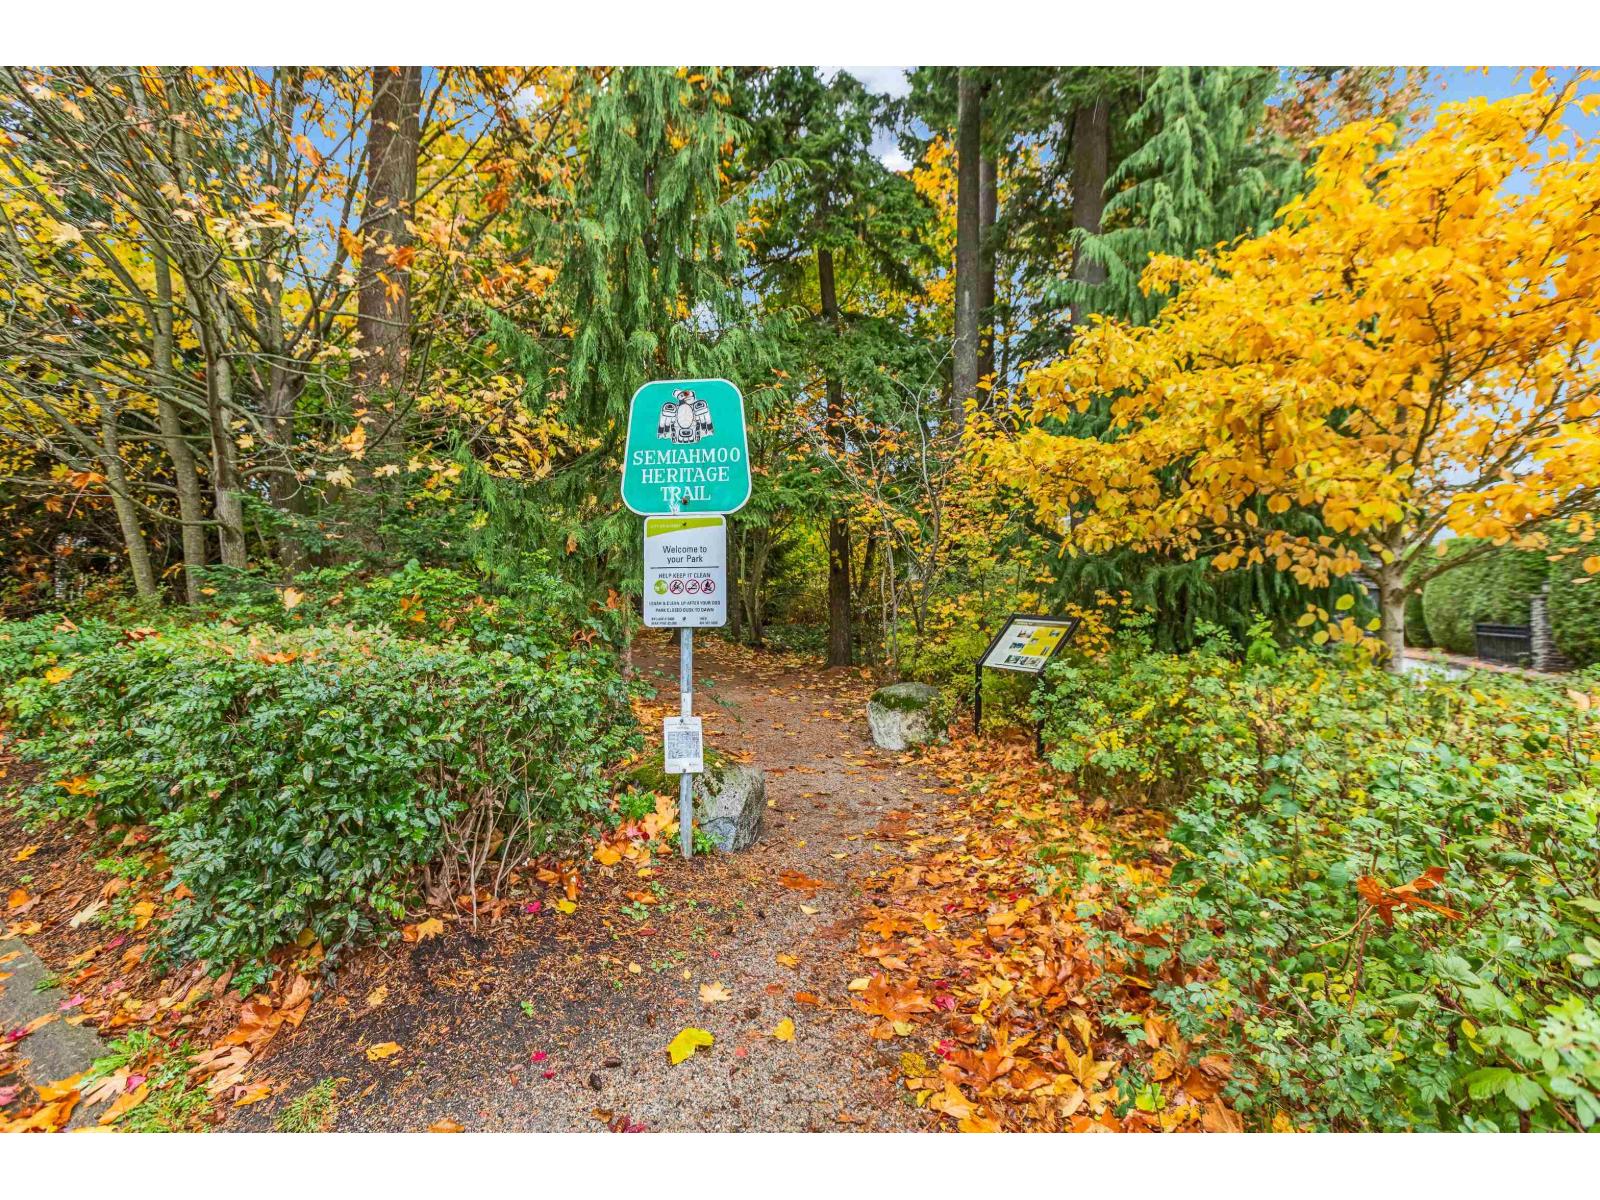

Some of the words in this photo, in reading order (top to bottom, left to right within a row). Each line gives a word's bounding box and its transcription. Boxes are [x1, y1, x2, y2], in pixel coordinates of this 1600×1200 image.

[633, 447, 740, 465] SEMIAHMOO
[641, 466, 730, 484] HERITAGE
[660, 485, 711, 502] TRAIL
